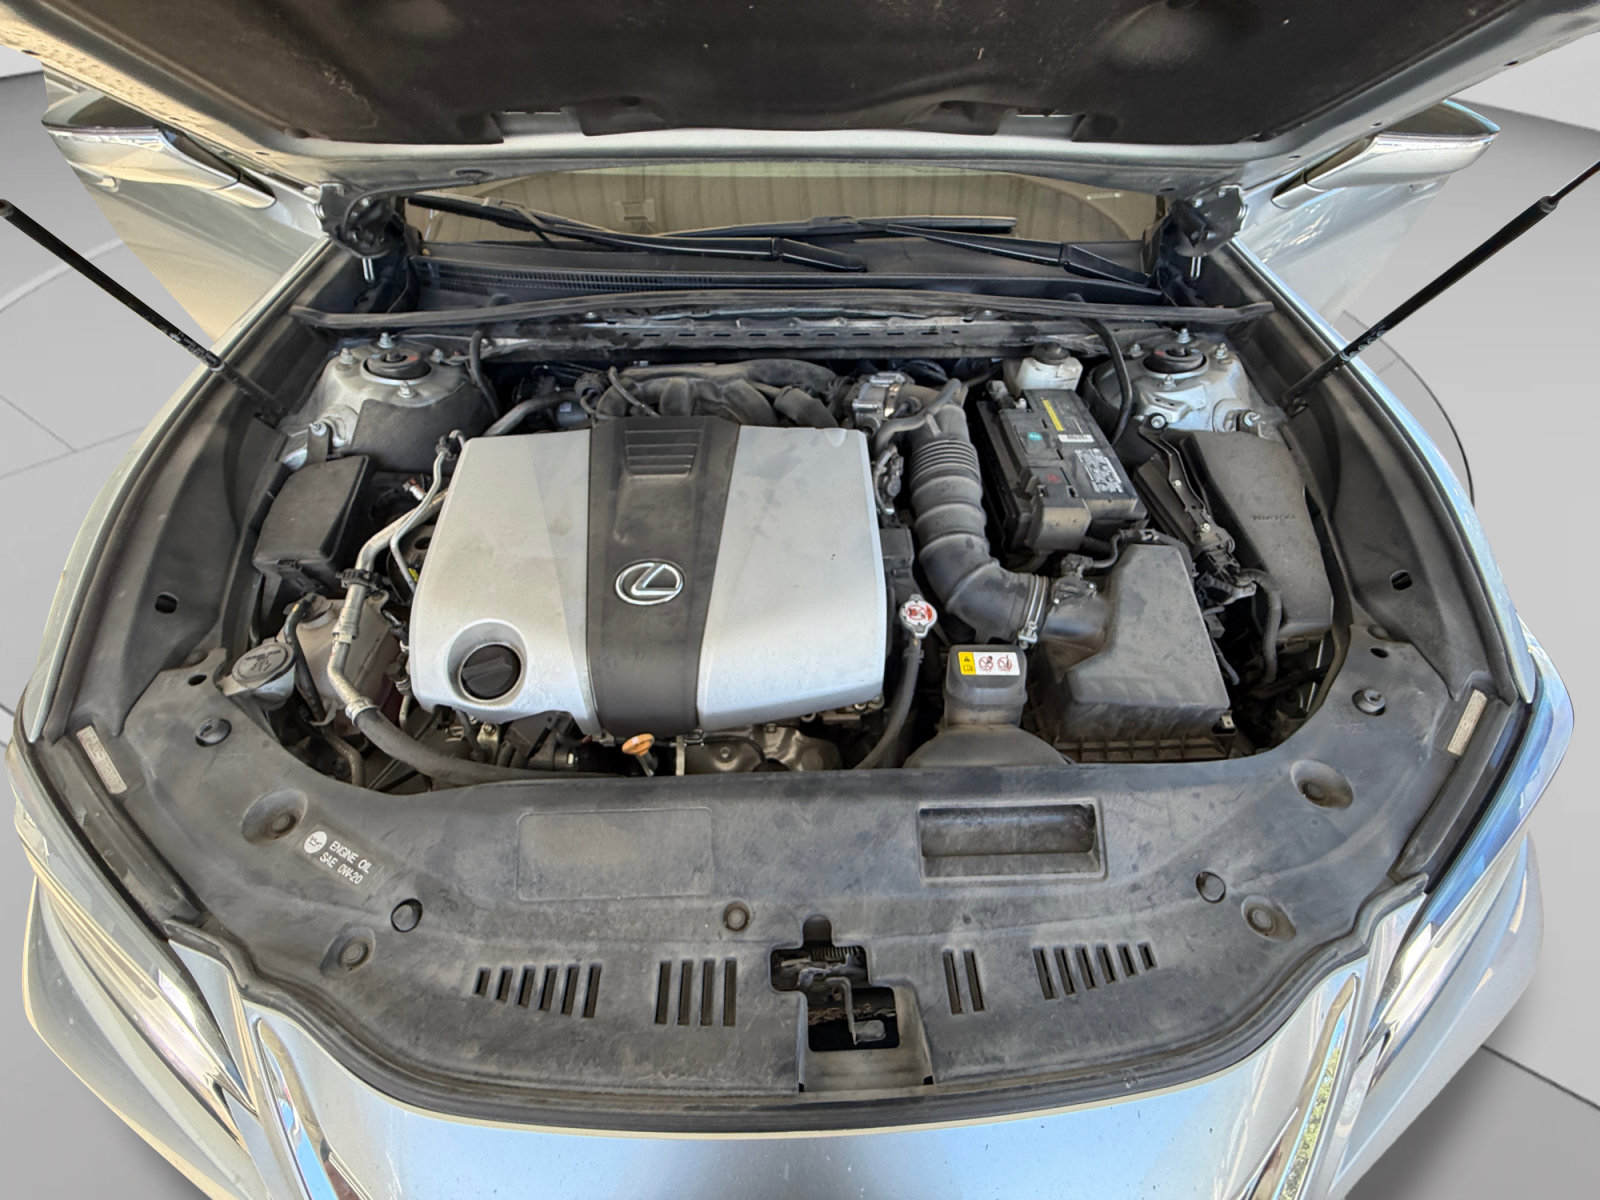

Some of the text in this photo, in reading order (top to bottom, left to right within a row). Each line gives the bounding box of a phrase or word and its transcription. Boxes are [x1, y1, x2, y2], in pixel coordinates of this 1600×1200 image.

[319, 852, 364, 885] SAE 0W-20
[329, 840, 372, 874] ENGINE OIL
